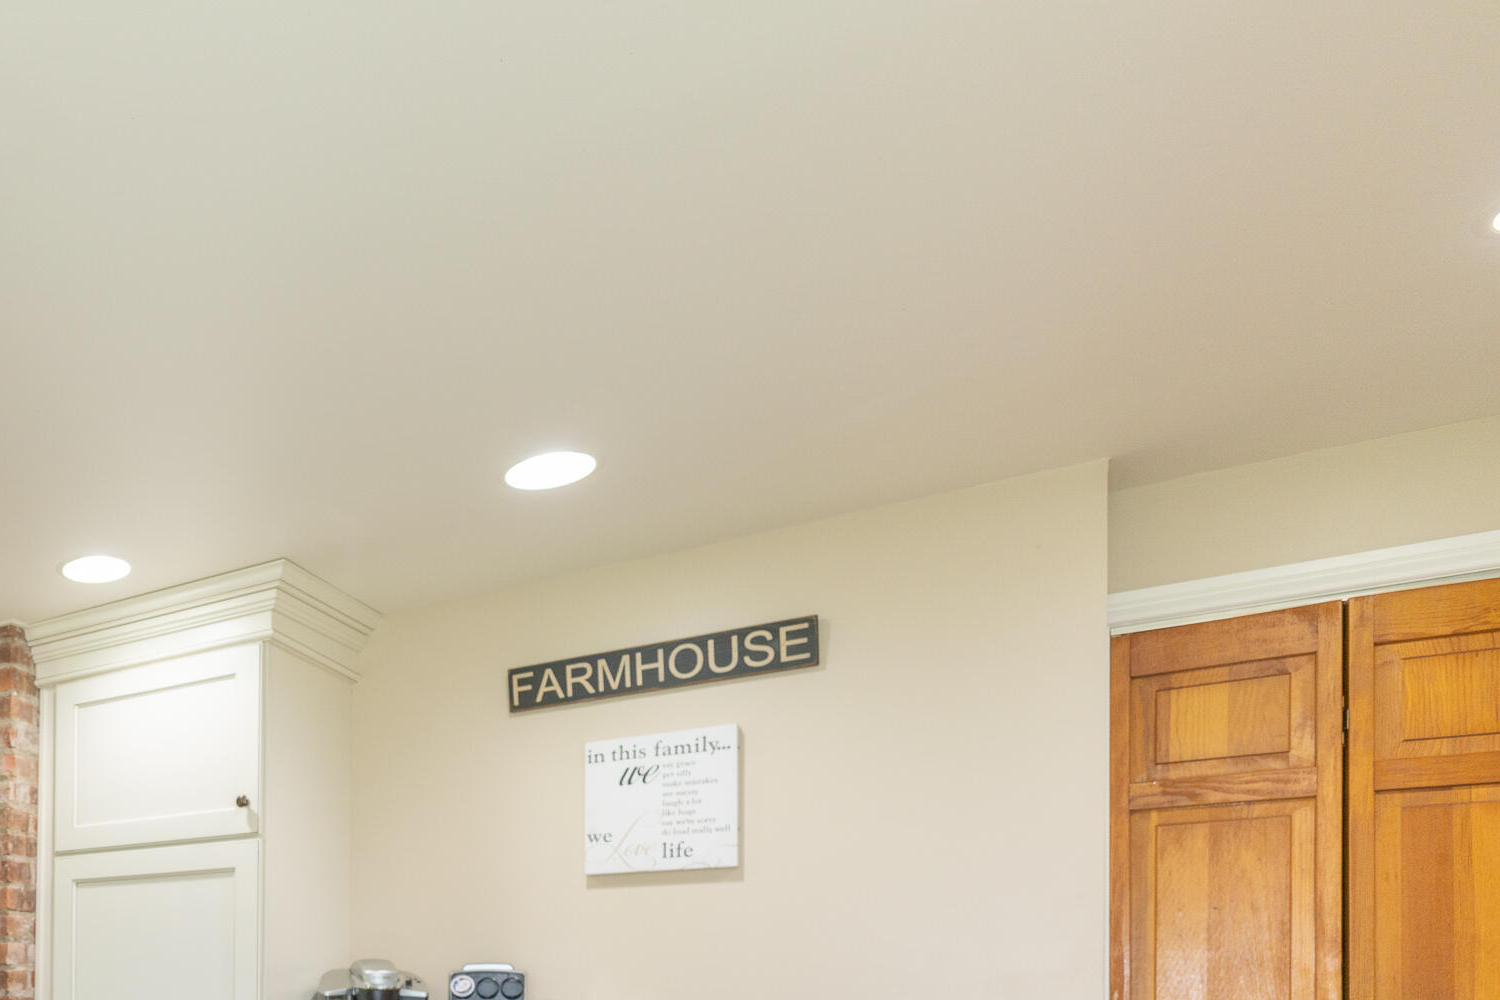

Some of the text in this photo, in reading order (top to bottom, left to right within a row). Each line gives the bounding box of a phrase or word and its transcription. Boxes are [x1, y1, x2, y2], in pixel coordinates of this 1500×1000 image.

[512, 622, 811, 706] FARMHOUSE
[587, 736, 731, 764] in this family...
[619, 764, 660, 786] we
[587, 832, 613, 843] we
[662, 841, 694, 858] life
